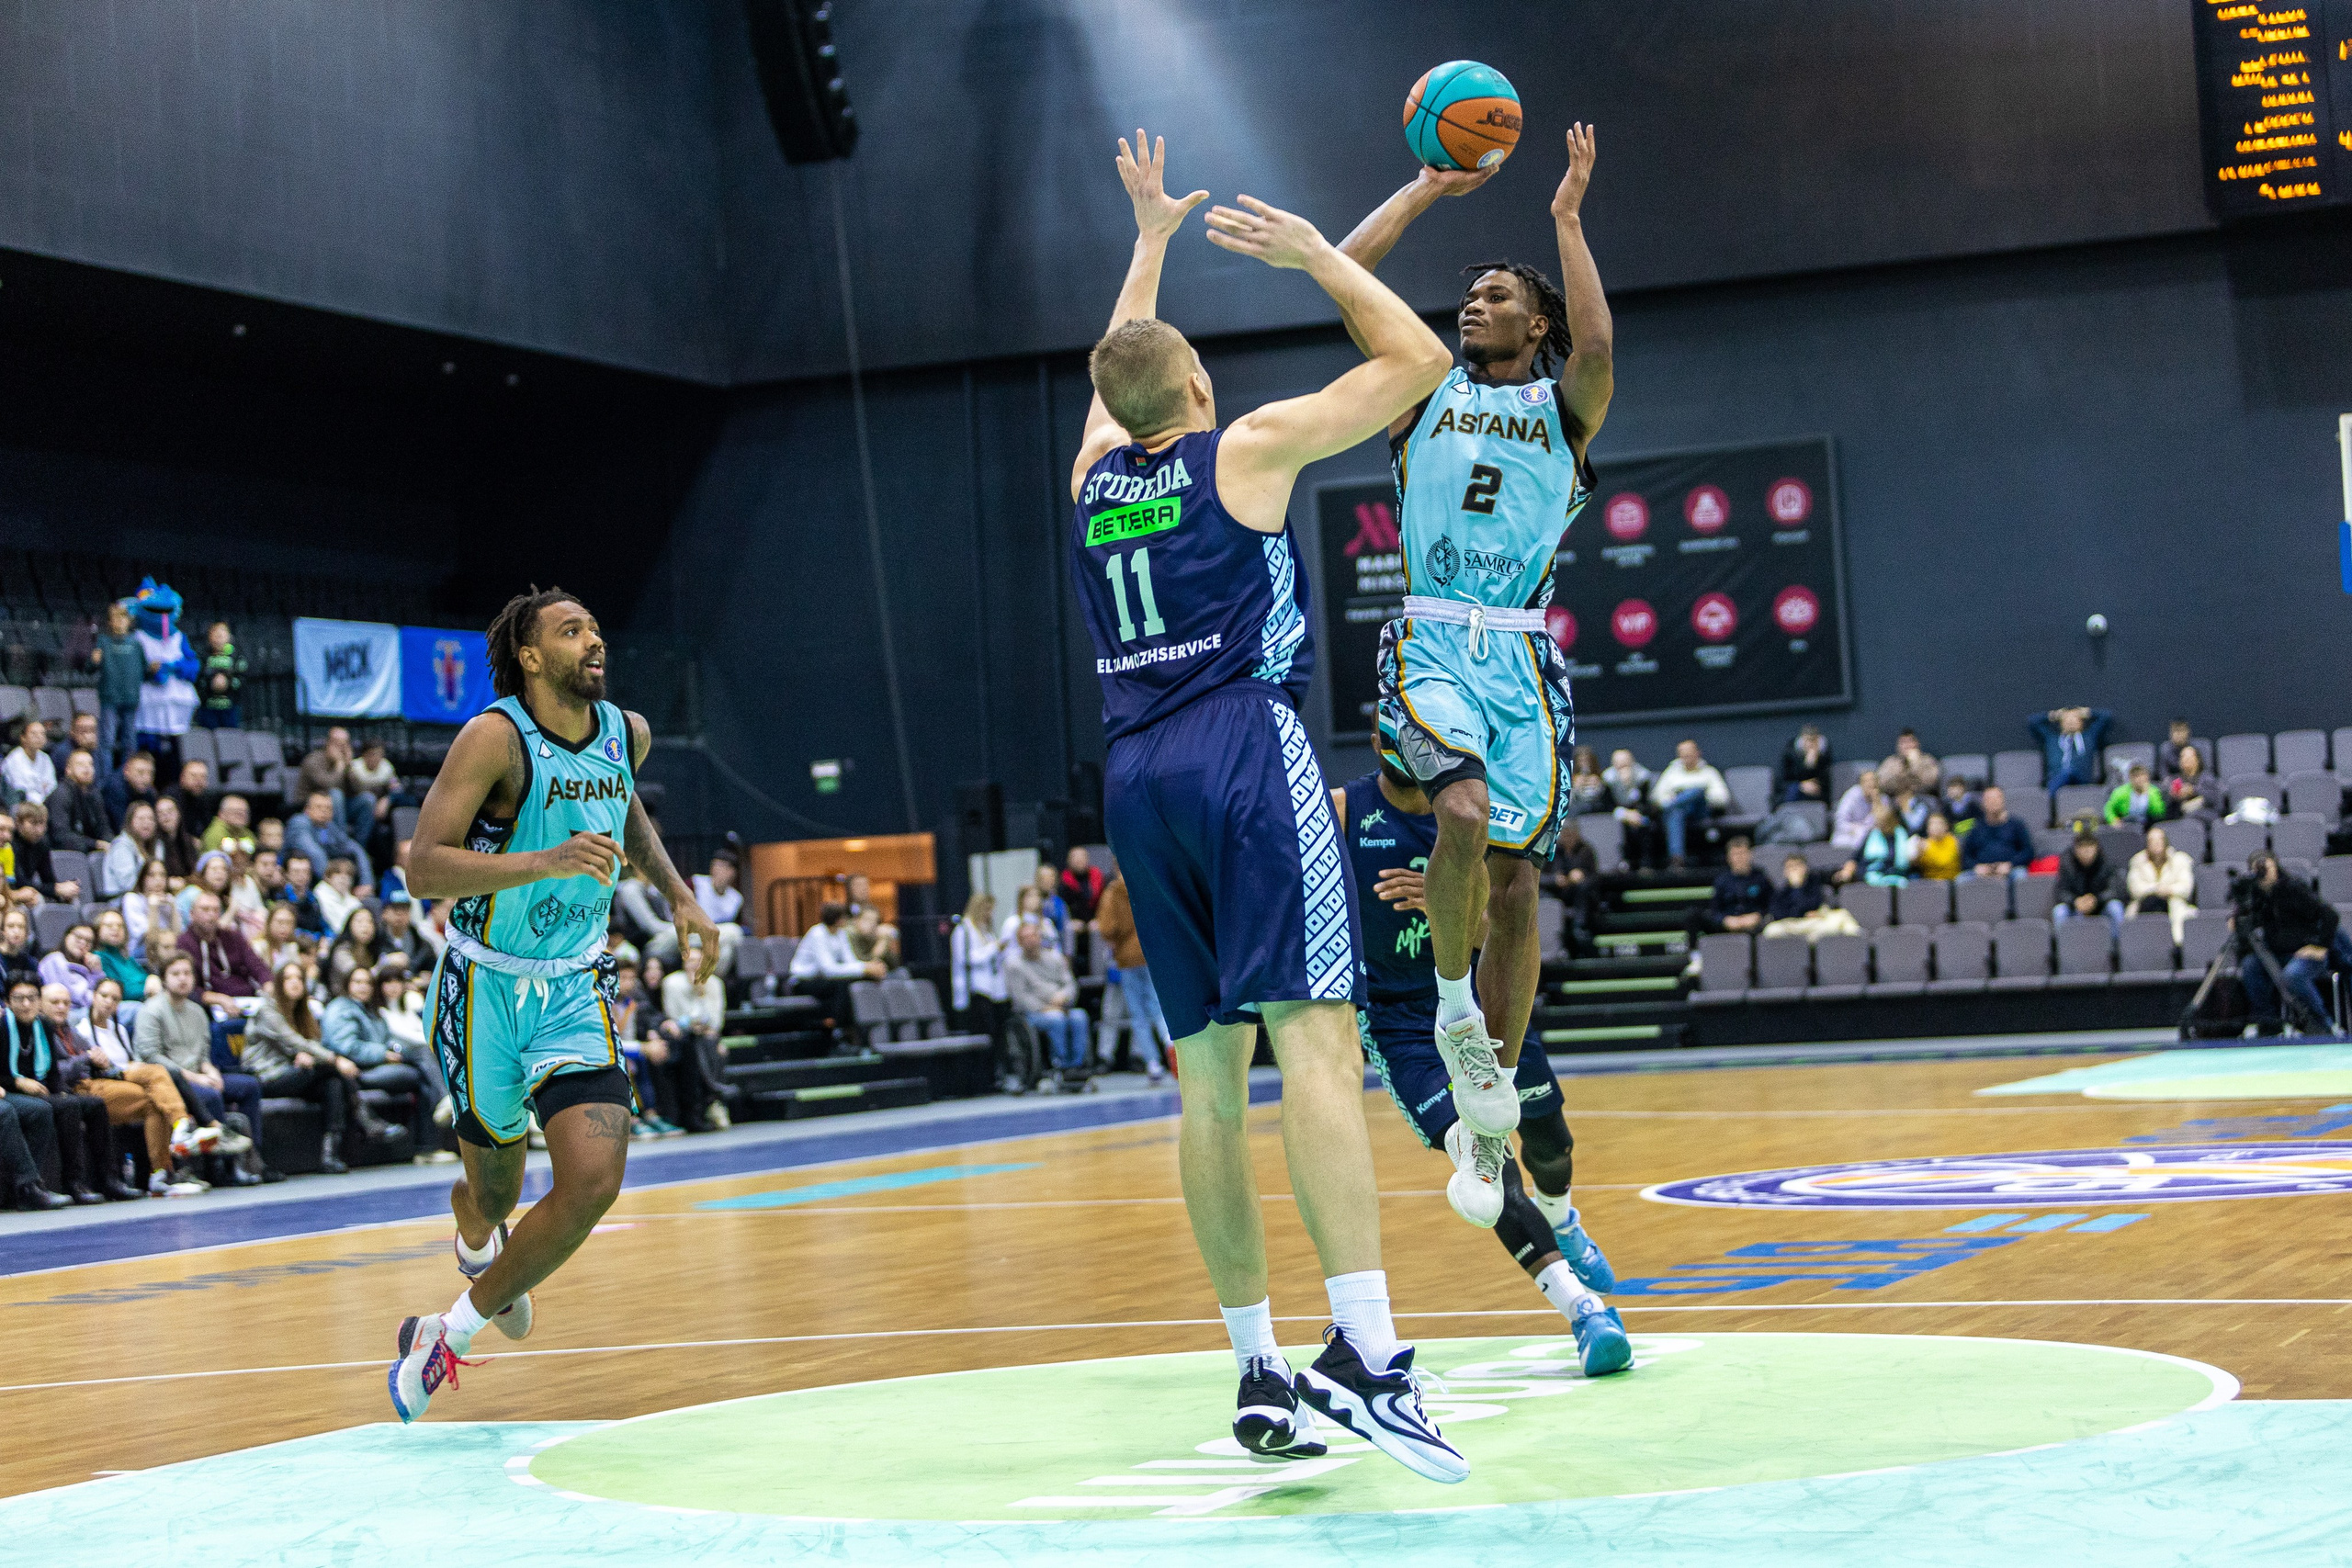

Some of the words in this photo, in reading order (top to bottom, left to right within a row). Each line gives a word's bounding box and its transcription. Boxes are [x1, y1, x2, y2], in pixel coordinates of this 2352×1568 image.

[1430, 407, 1552, 454] ASTANA
[1084, 457, 1193, 505] STUBEDA
[1461, 463, 1503, 514] 2
[1092, 505, 1174, 539] BETERA
[1464, 551, 1526, 574] SAMRUK
[1105, 547, 1166, 643] 11
[544, 773, 627, 809] ASTANA
[1359, 837, 1396, 850] Kempa
[1416, 1088, 1449, 1115] Kempa
